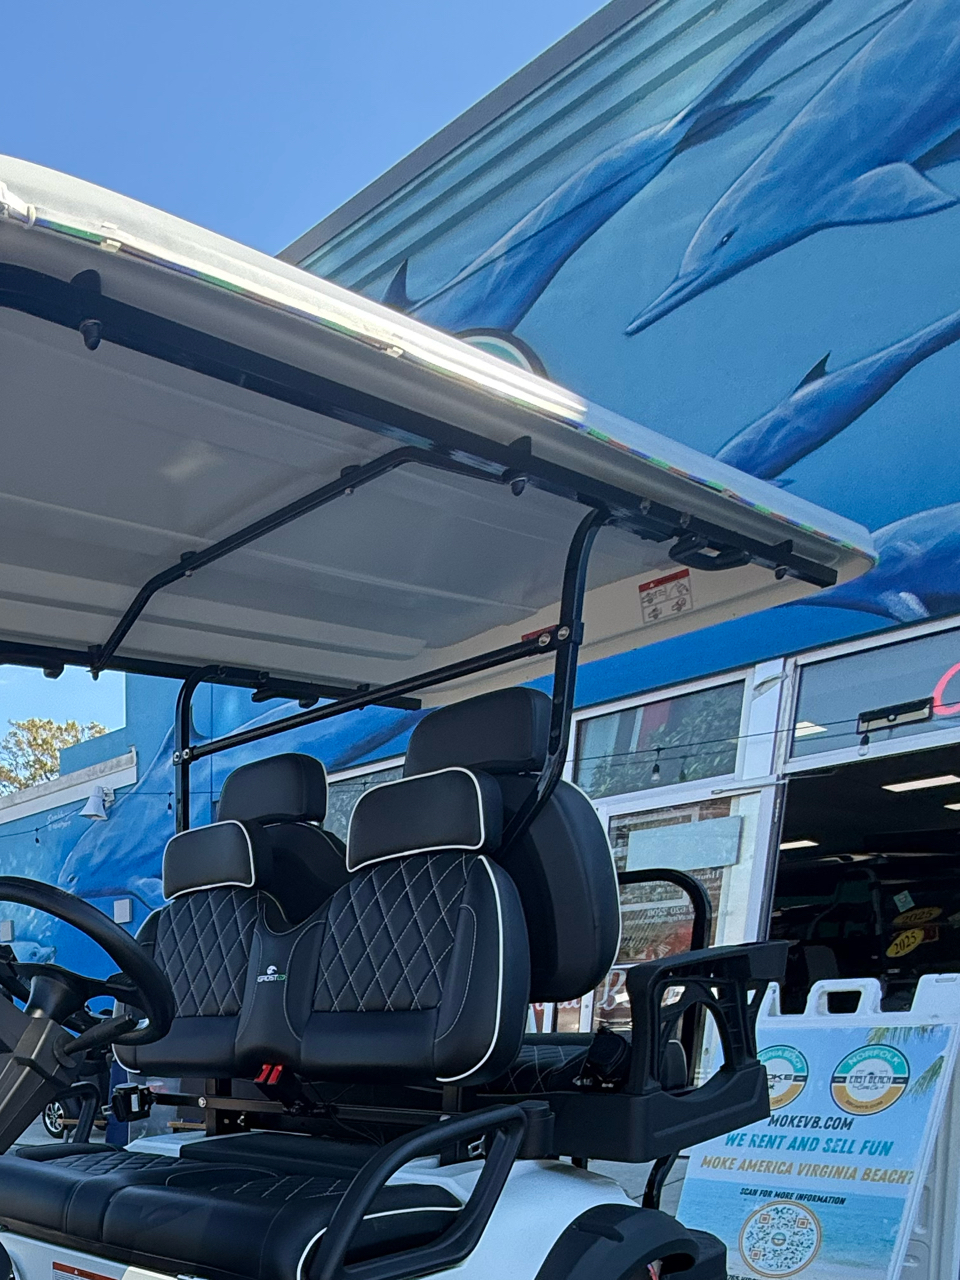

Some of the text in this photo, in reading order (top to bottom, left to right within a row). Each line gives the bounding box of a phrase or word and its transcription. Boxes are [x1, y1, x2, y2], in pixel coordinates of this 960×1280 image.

[894, 931, 917, 955] 2025
[848, 1049, 901, 1066] NORFOLK
[767, 1073, 793, 1081] OKE
[767, 1114, 855, 1131] MOKEVB.COM
[725, 1133, 894, 1157] WE RENT AND SELL FUN
[700, 1155, 736, 1170] MOKE
[737, 1159, 794, 1176] AMERICA
[796, 1163, 858, 1181] VIRGINIA
[740, 1187, 847, 1206] SCAN FOR MORE INFORMATION
